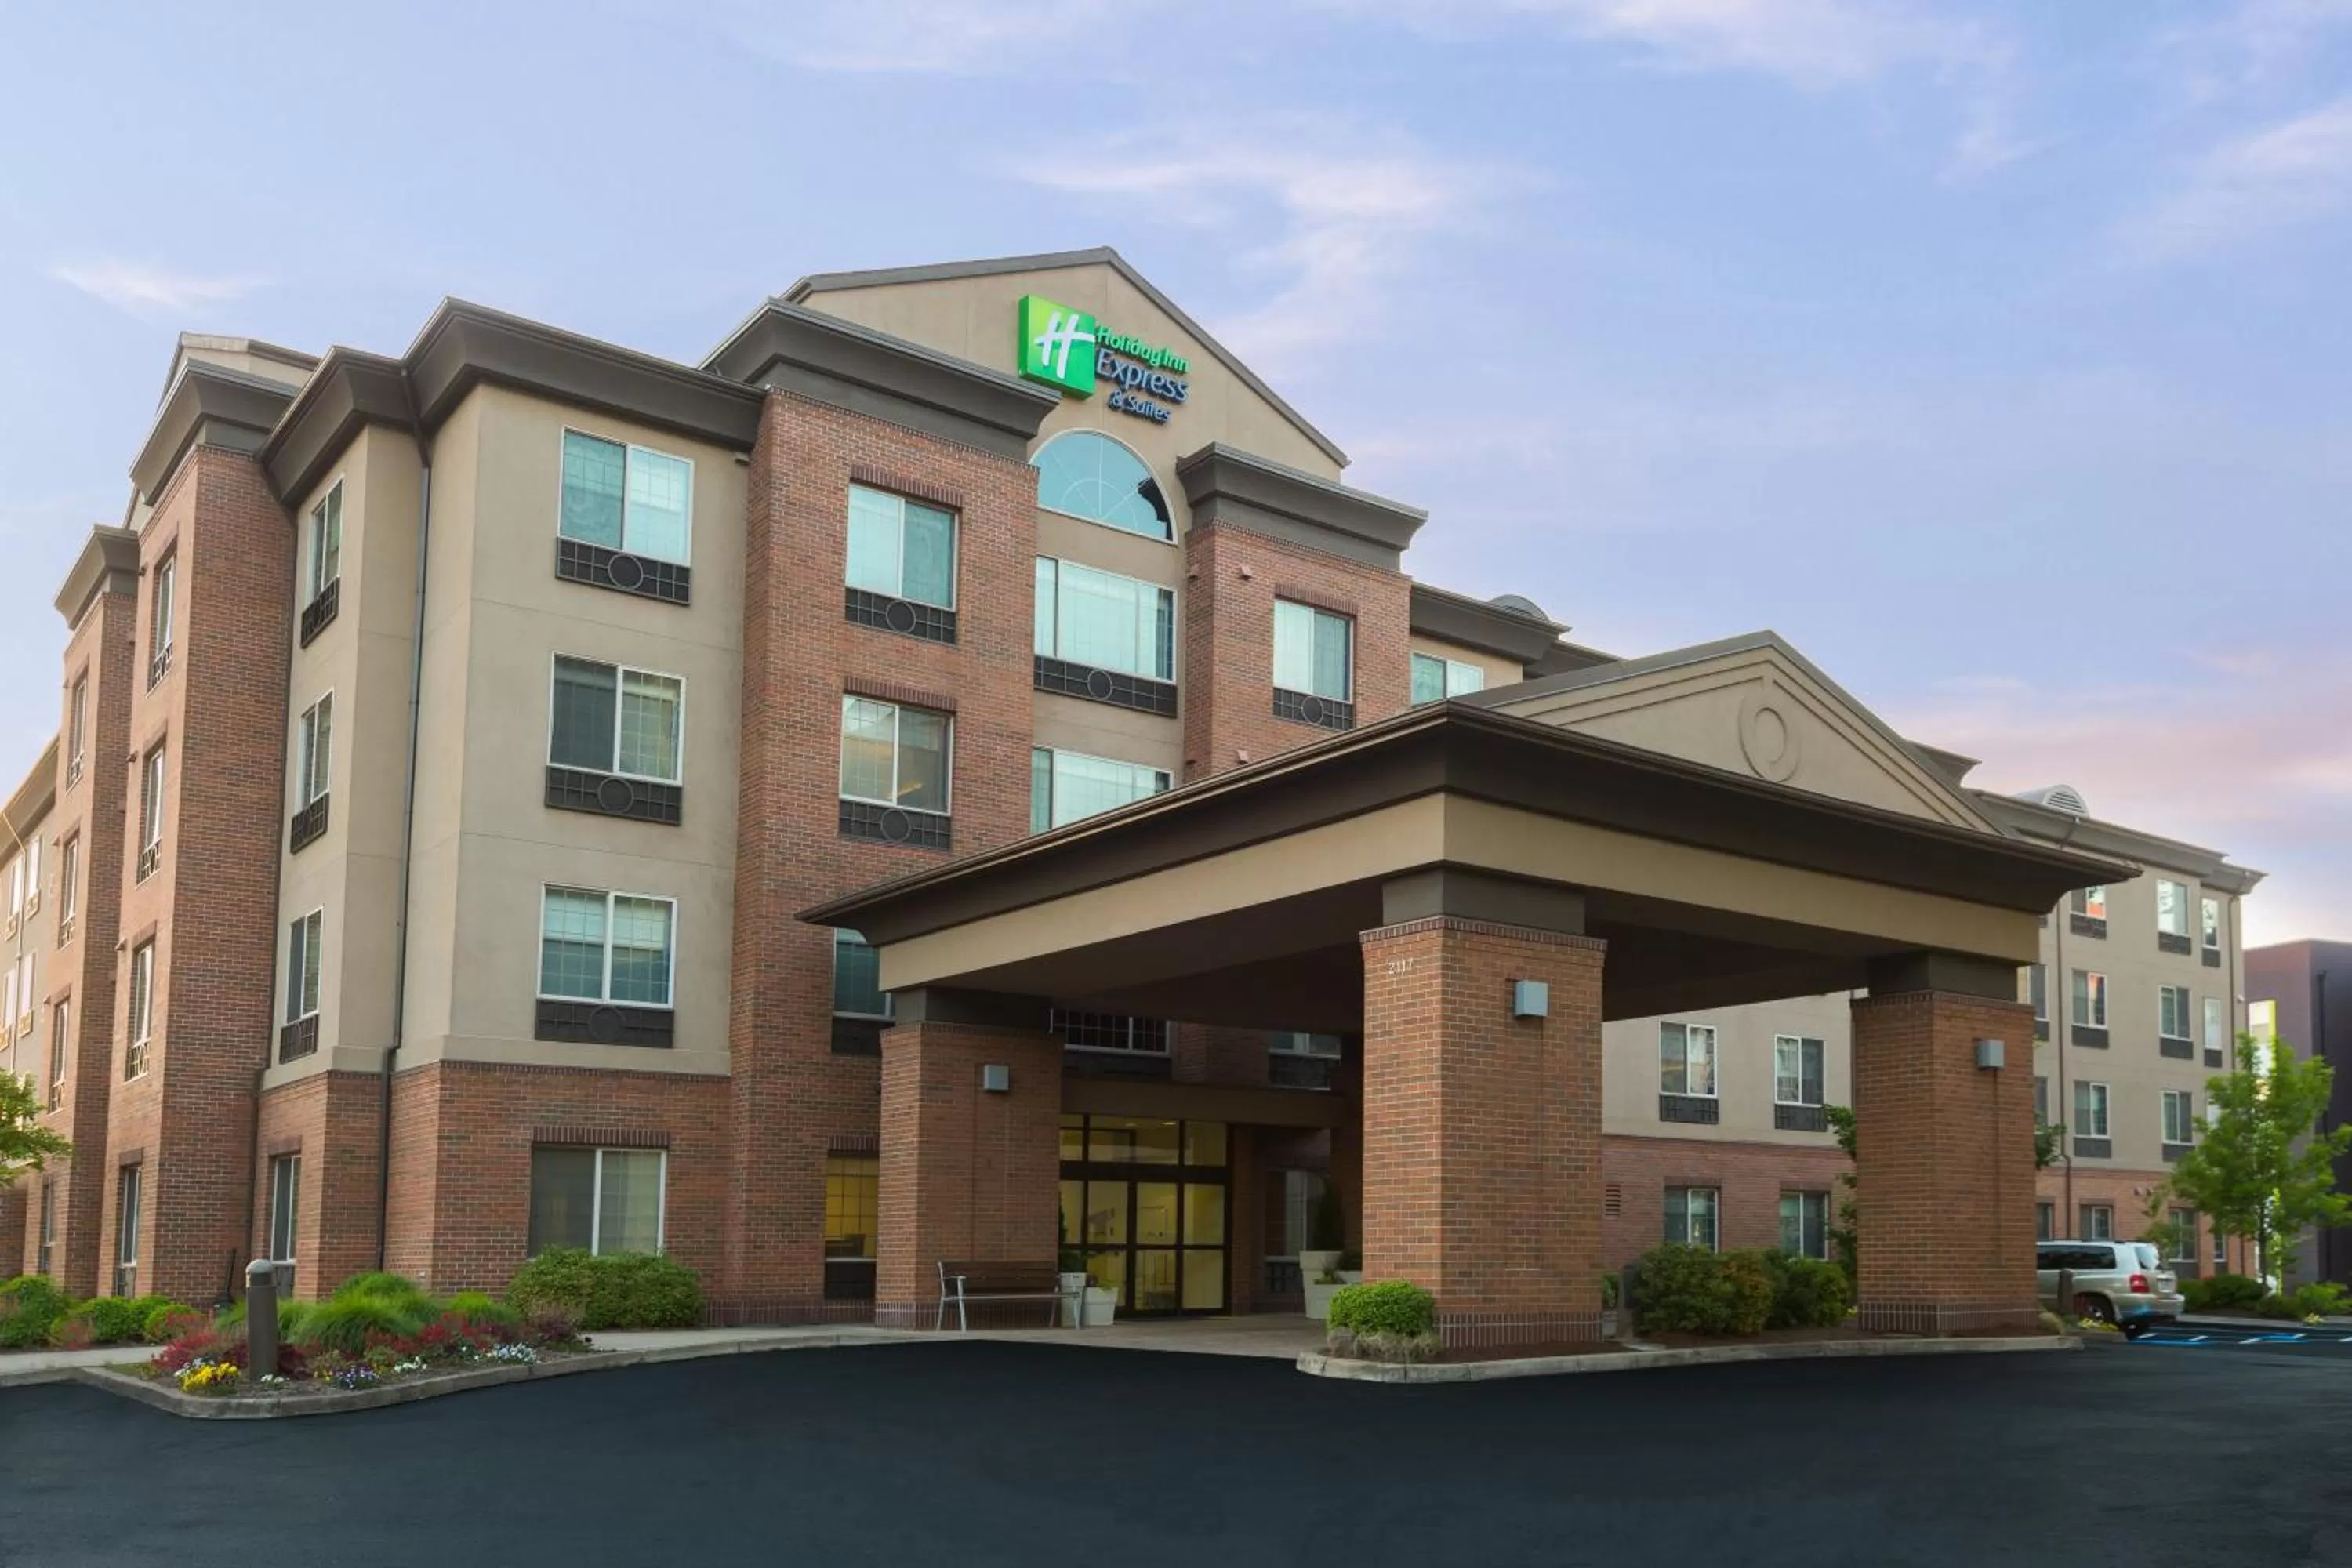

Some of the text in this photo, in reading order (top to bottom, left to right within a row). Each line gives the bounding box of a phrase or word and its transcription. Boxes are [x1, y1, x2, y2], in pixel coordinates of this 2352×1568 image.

[1096, 325, 1190, 373] Holiday Inn
[1097, 347, 1189, 402] Express
[1110, 390, 1171, 422] & Suites
